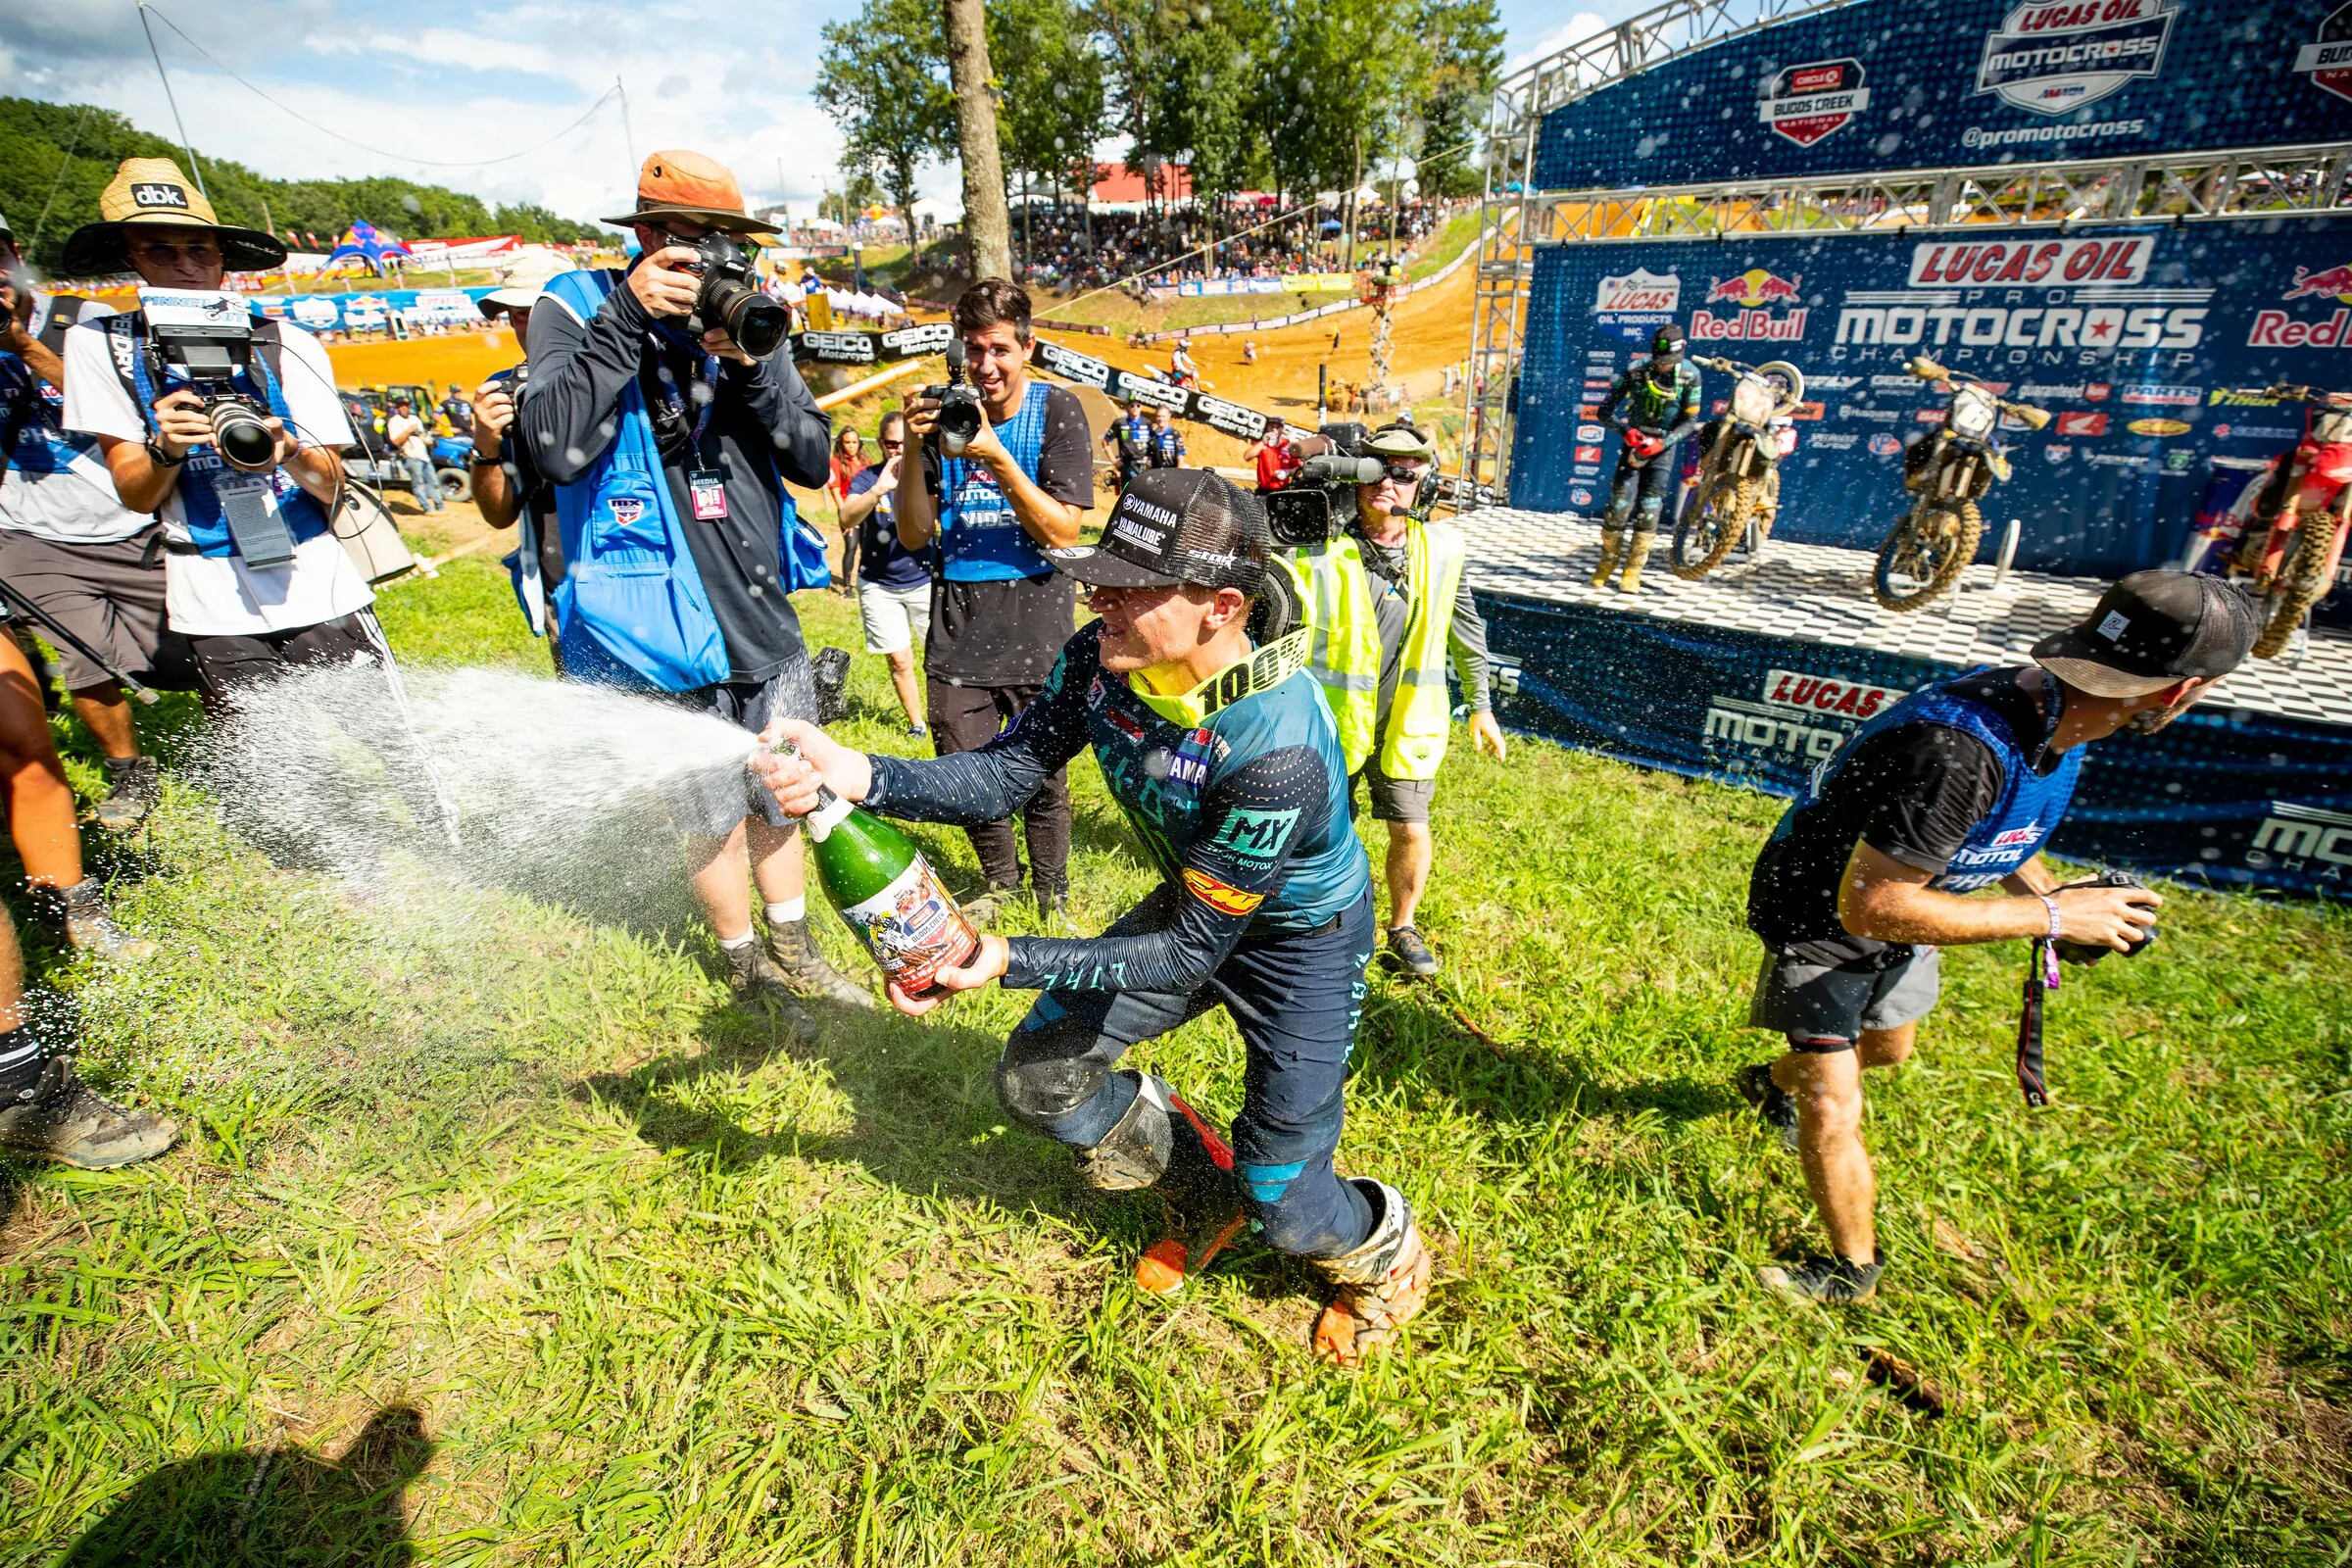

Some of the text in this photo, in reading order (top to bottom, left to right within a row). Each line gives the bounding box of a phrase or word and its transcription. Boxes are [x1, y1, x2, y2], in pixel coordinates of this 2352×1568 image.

[2019, 0, 2142, 31] LUCAS OIL
[1987, 35, 2160, 72] MOTOCROSS
[1774, 94, 1854, 117] BUDDS CREEK
[1962, 119, 2145, 148] @promotocross
[1918, 240, 2138, 283] LUCAS OIL
[1604, 291, 1675, 311] LUCAS
[1965, 289, 2067, 305] PRO
[1597, 315, 1673, 324] OIL PRODUCTS
[1835, 307, 2210, 348] MOTOCROSS
[2246, 307, 2349, 347] Red
[803, 332, 873, 352] GEICO
[882, 323, 955, 349] GEICO
[1041, 343, 1110, 382] GEICO
[1830, 345, 2196, 365] CHAMPIONSHIP
[1118, 371, 1190, 404] GEICO
[1871, 374, 1927, 387] GEICO
[1197, 395, 1267, 431] GEICO
[692, 477, 719, 486] MEDIA
[1133, 499, 1178, 529] YAMAHA
[1118, 515, 1162, 546] YAMALUBE
[1198, 631, 1306, 716] 100%
[1770, 674, 1885, 718] LUCAS
[1704, 708, 1844, 760] MOTO
